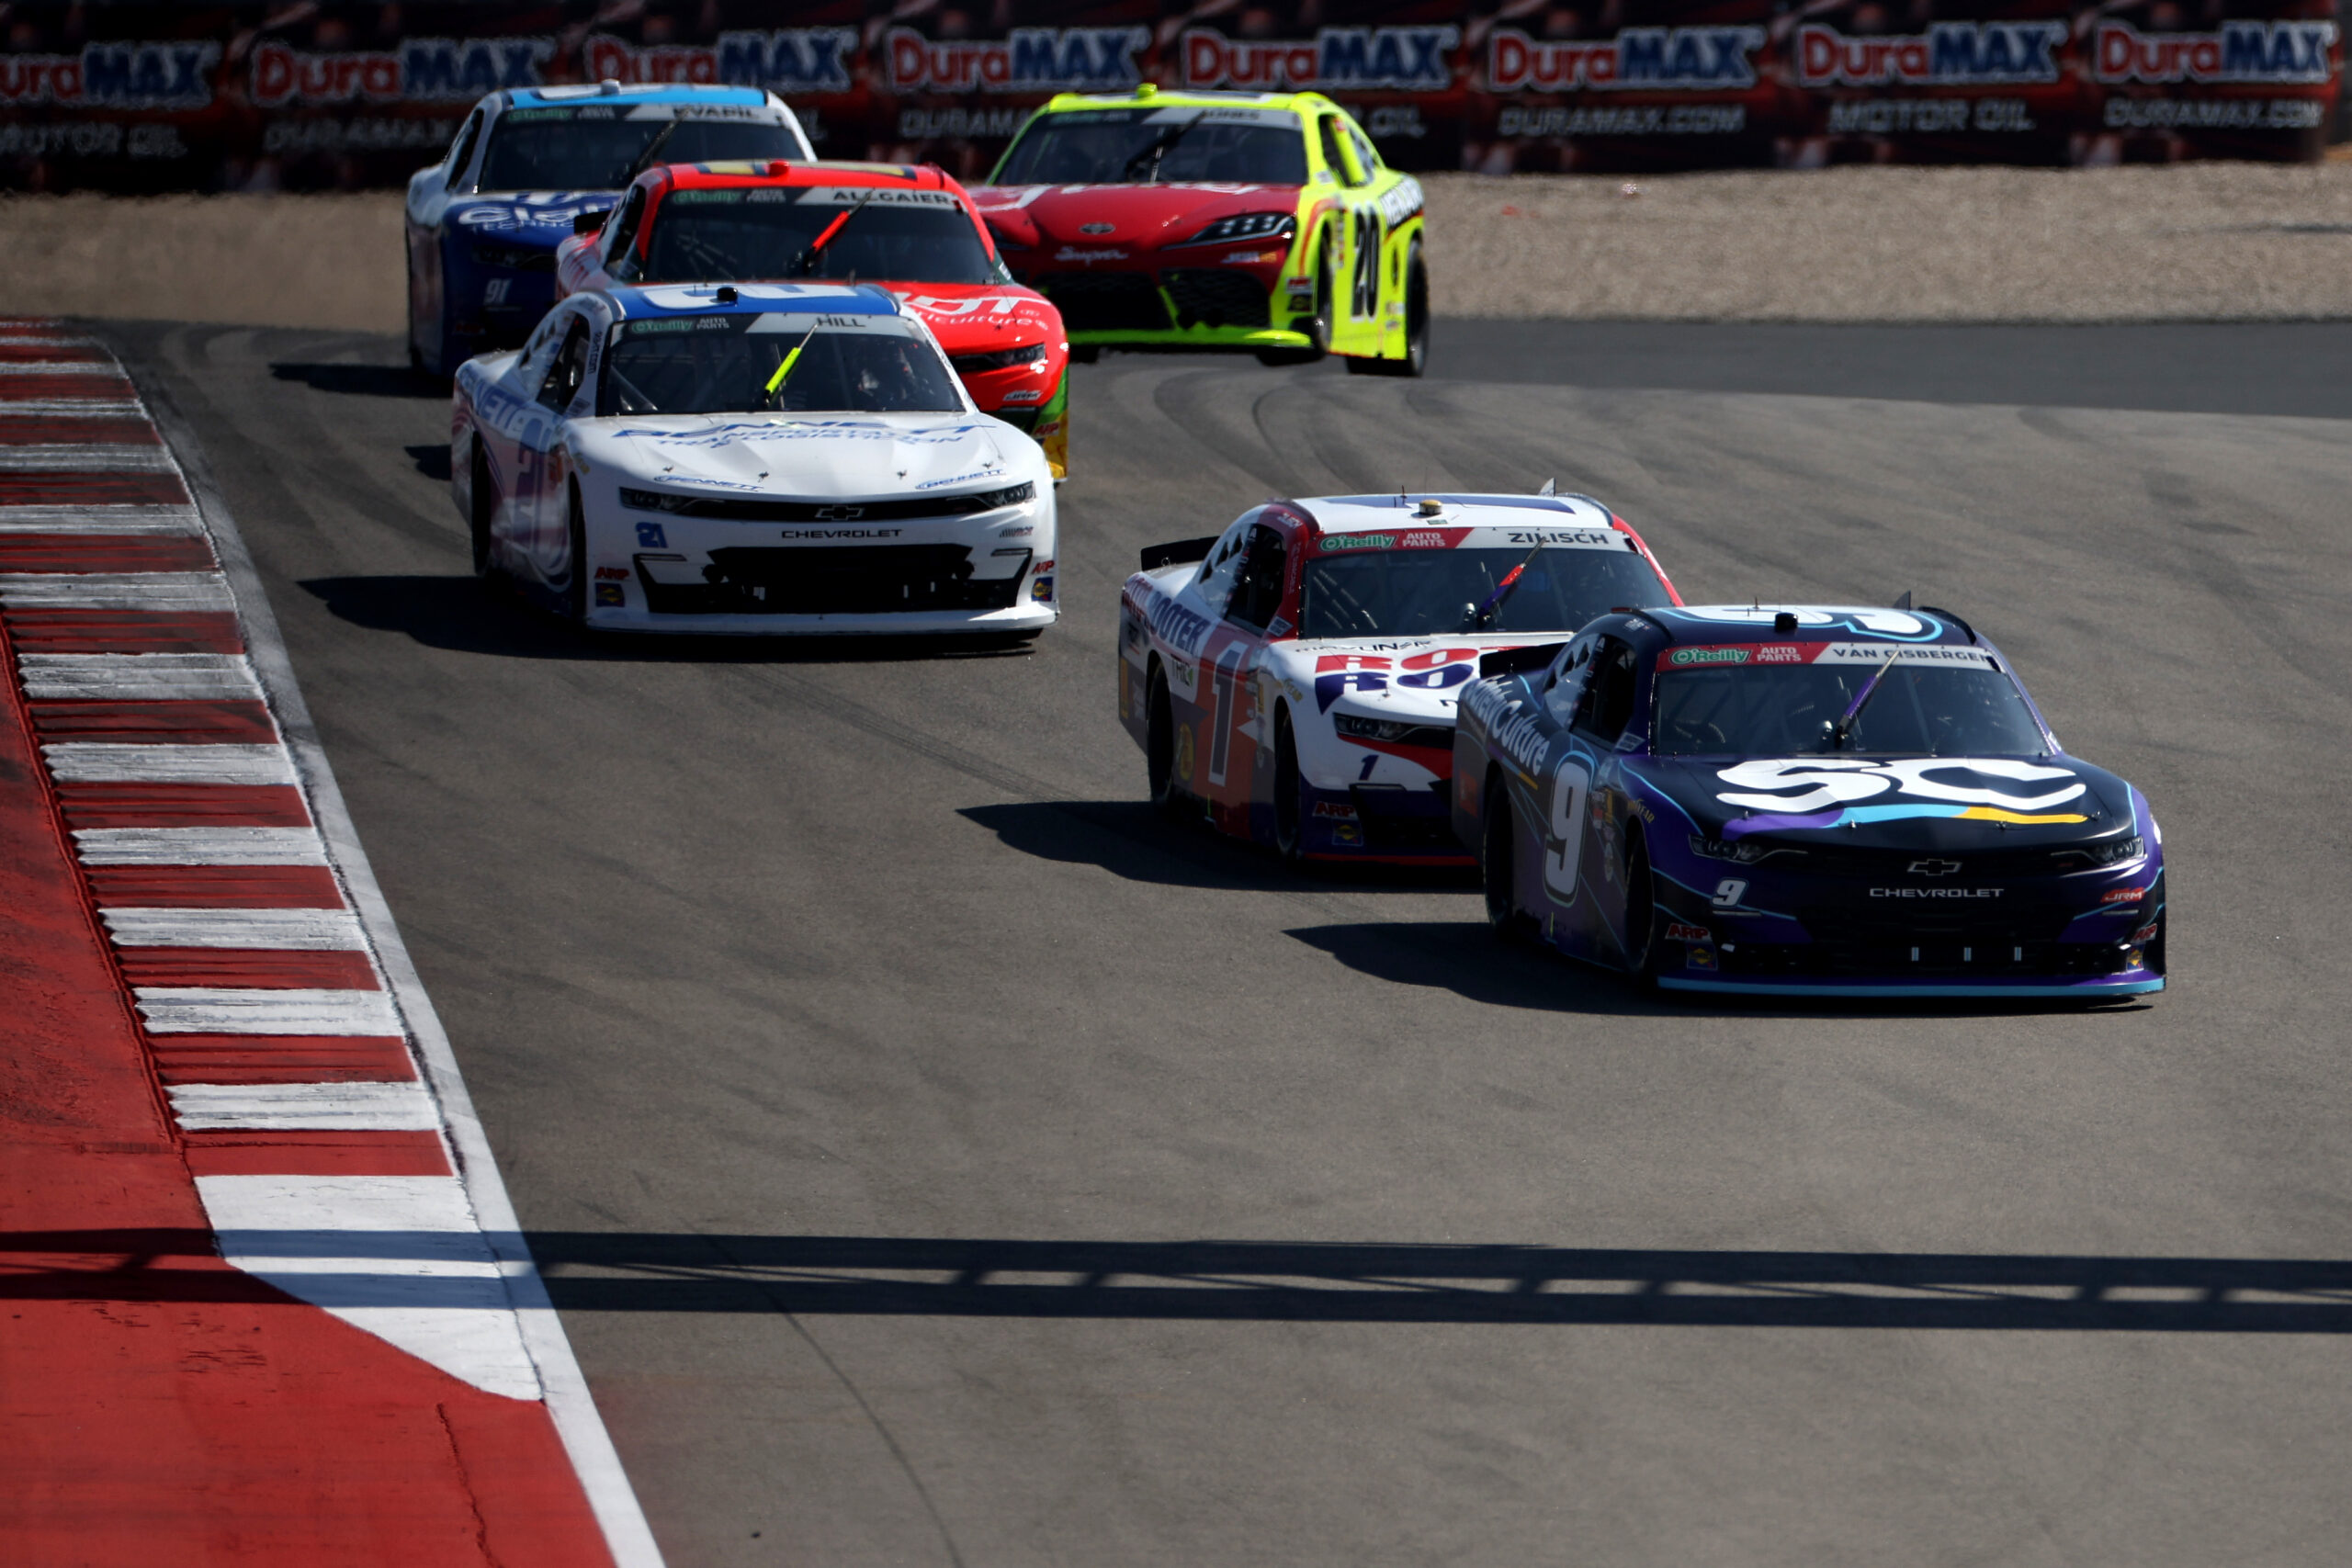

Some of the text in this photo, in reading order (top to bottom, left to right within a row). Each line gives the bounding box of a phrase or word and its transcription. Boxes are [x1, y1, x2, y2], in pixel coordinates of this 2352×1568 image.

[588, 33, 847, 85] DuraMAX
[889, 28, 1139, 87] DuraMAX
[1188, 28, 1448, 86] DuraMAX
[1493, 28, 1755, 86] DuraMAX
[1801, 25, 2058, 83] DuraMAX
[2098, 22, 2327, 82] DuraMAX
[0, 42, 204, 103] uraMAX
[254, 42, 542, 100] DuraMAX
[1498, 106, 1744, 136] DURAMAX.COM
[1828, 98, 2036, 132] MOTOR OIL
[2102, 98, 2324, 129] DURAMAX.COM
[483, 278, 513, 304] 91
[815, 316, 866, 329] HILL
[636, 522, 668, 548] 21
[781, 528, 904, 539] CHEVROLET
[1317, 534, 1396, 553] O'Reilly
[1401, 539, 1446, 548] PARTS
[1406, 532, 1442, 540] AUTO
[1507, 533, 1610, 546] ZILISCH
[594, 567, 630, 580] ARP
[1031, 559, 1055, 575] ARP
[1668, 649, 1752, 665] O'Reilly
[1756, 653, 1802, 662] PARTS
[1760, 647, 1797, 655] AUTO
[1833, 649, 1877, 658] VAN
[1206, 639, 1250, 787] 1
[1358, 754, 1379, 781] 1
[1315, 801, 1356, 818] ARP
[1543, 756, 1593, 900] 9
[1712, 877, 1749, 907] 9
[1869, 886, 2005, 899] CHEVROLET
[2104, 889, 2143, 901] JRM
[1668, 924, 1710, 940] ARP
[2134, 925, 2157, 941] ARP
